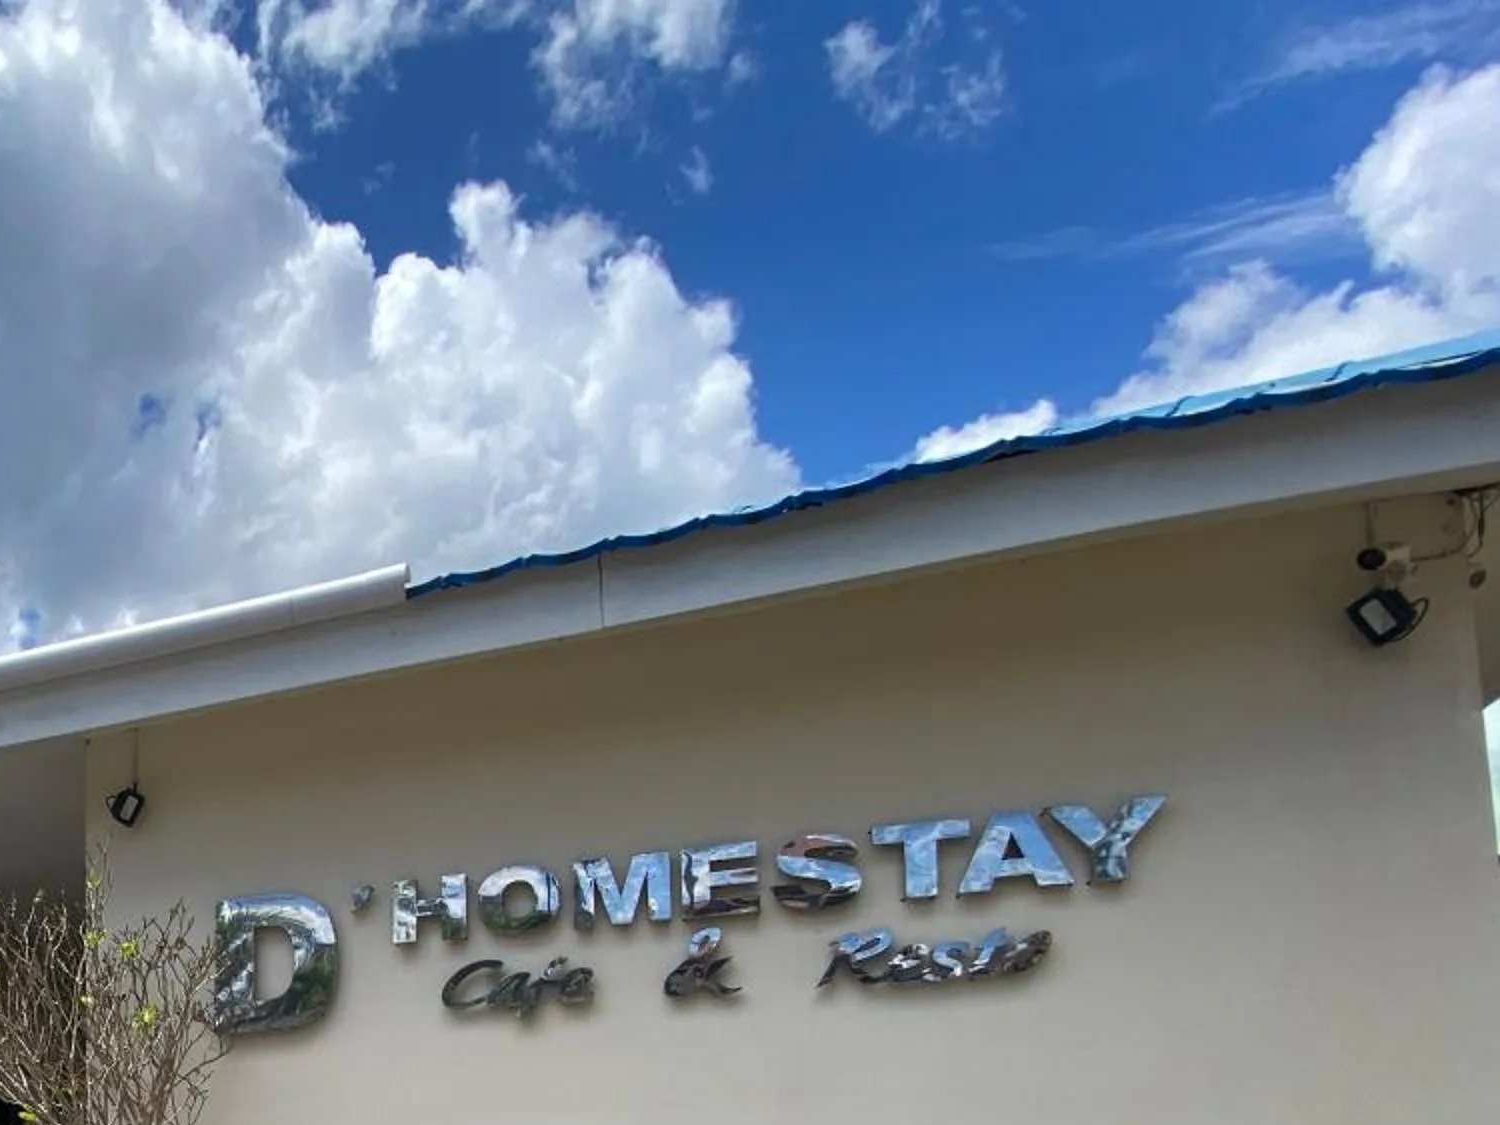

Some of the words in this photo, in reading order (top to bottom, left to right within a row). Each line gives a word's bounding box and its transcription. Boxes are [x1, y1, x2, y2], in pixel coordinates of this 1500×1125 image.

[214, 793, 1168, 1034] D'HOMESTAY
[442, 956, 595, 1018] Cafe
[664, 926, 743, 997] &
[814, 926, 1052, 988] Resto
